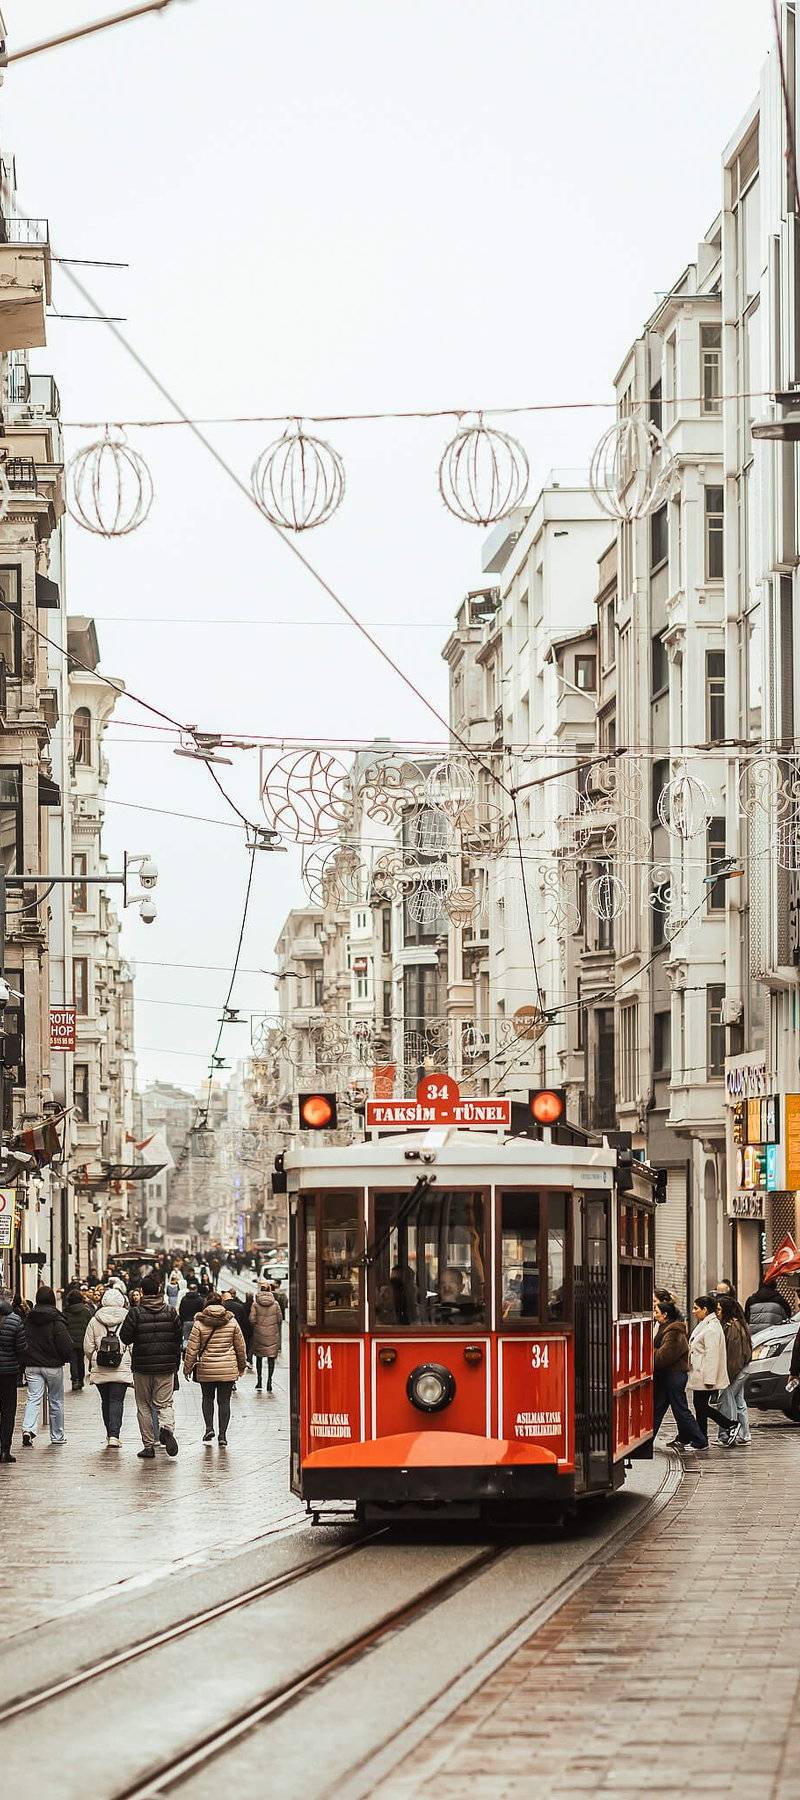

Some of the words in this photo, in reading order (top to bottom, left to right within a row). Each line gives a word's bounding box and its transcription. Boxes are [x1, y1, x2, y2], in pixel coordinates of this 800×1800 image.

[427, 1085, 449, 1100] 34
[373, 1103, 436, 1122] TAKSİM
[453, 1103, 506, 1122] TÜNEL
[317, 1345, 332, 1370] 34
[532, 1344, 549, 1368] 34
[329, 1413, 349, 1425] YASAK
